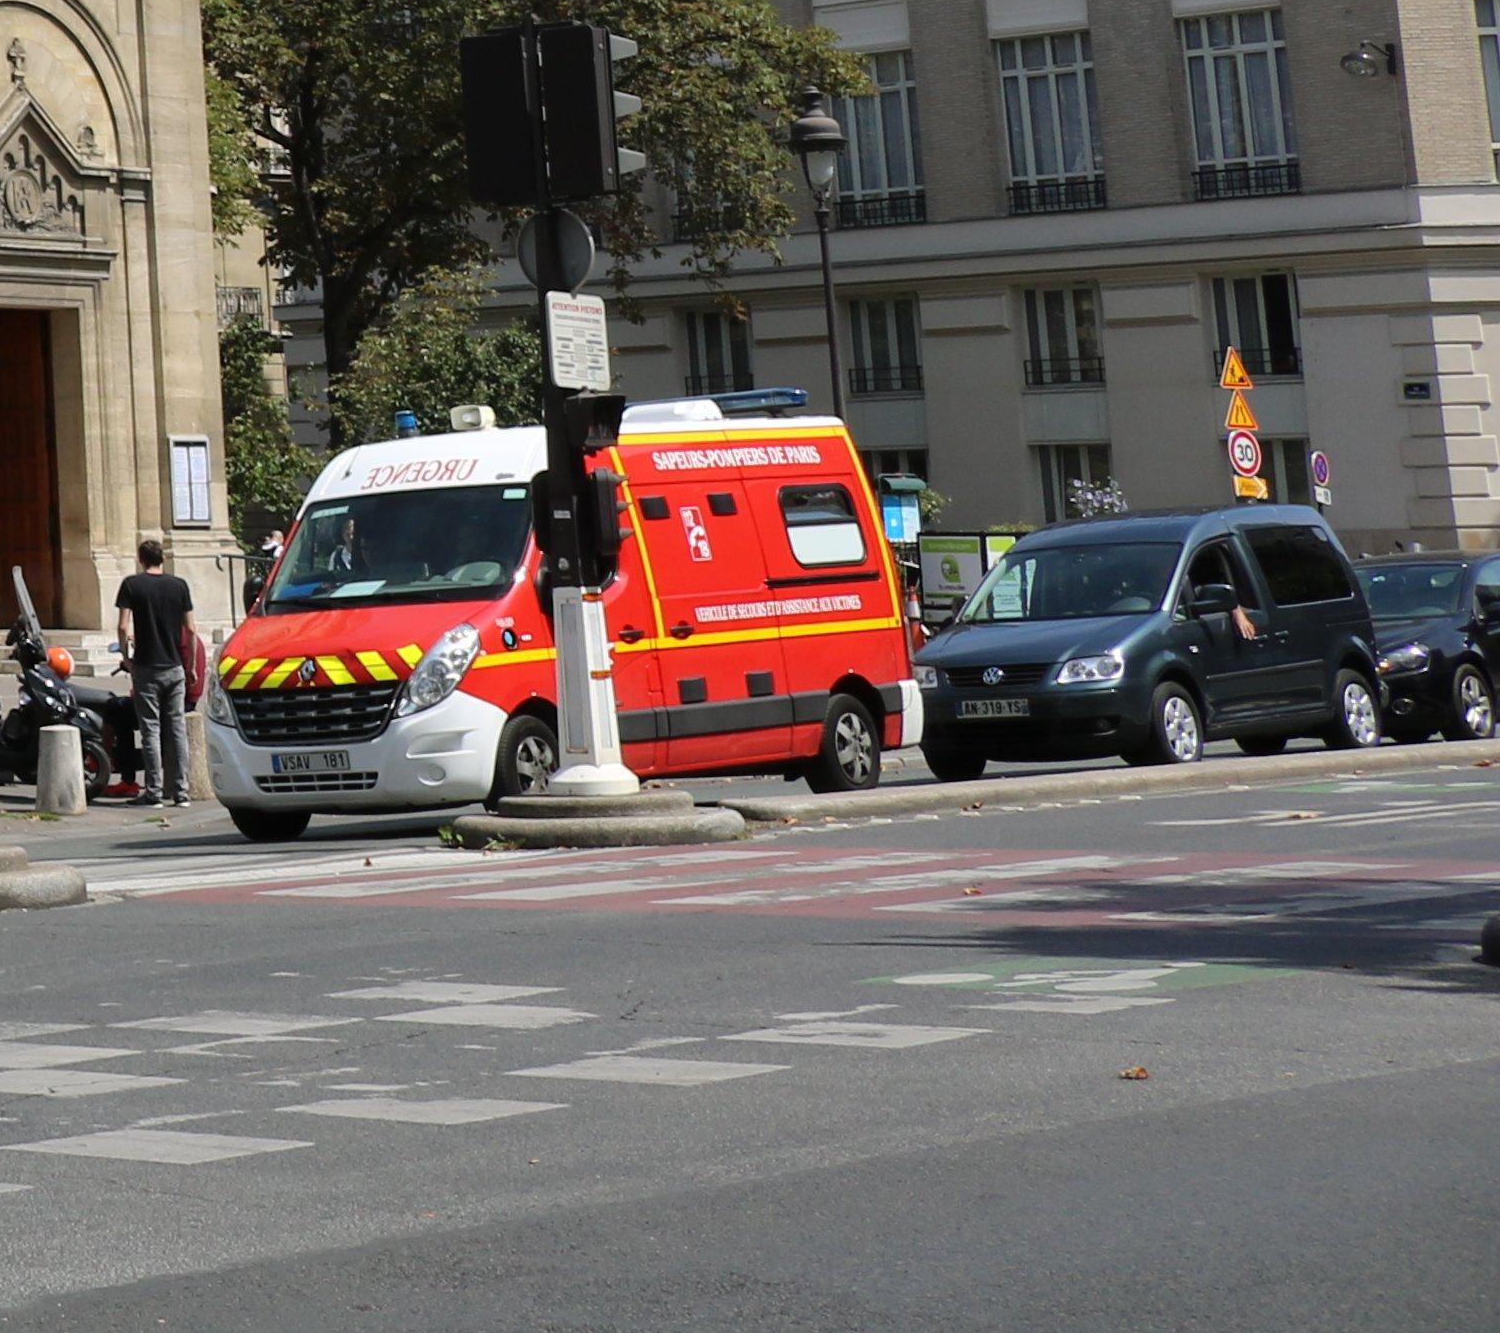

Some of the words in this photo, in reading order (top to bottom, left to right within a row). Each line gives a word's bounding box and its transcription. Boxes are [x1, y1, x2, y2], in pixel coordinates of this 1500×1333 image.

[652, 448, 768, 471] SAPEURS-POMPIERS
[767, 447, 784, 465] DE
[784, 445, 821, 464] PARIS
[1237, 444, 1254, 461] 30
[281, 754, 311, 770] VSAV
[323, 753, 345, 768] 181
